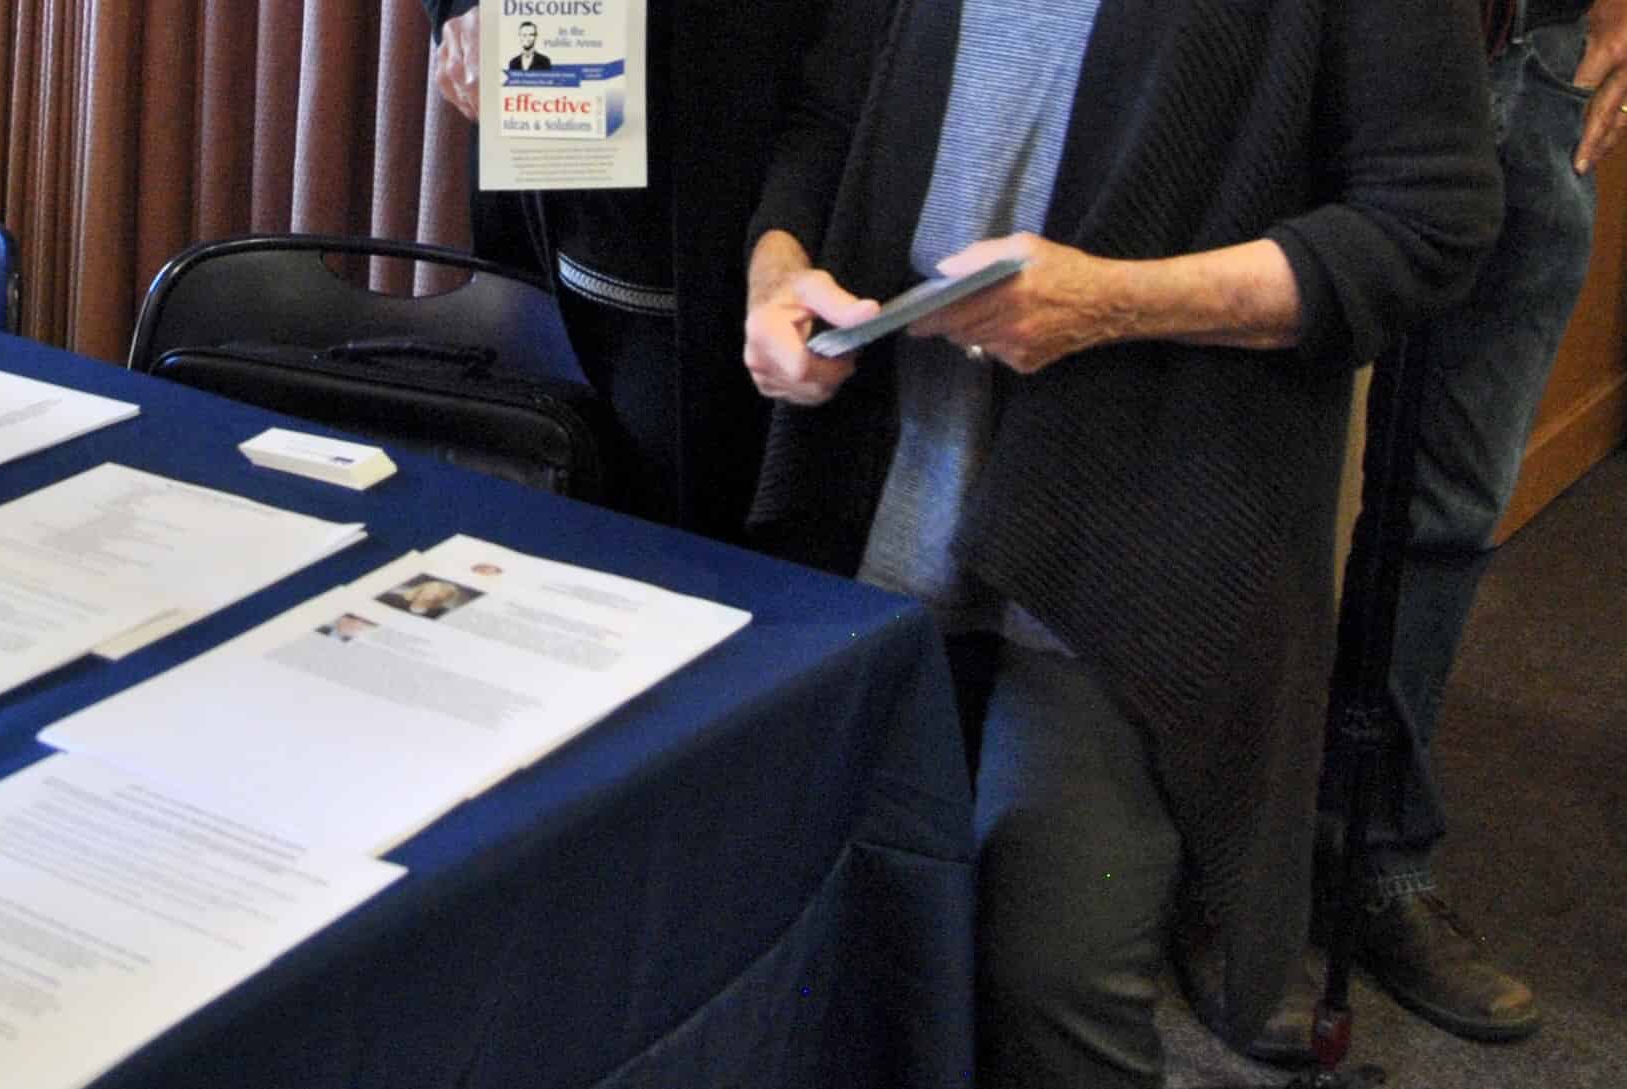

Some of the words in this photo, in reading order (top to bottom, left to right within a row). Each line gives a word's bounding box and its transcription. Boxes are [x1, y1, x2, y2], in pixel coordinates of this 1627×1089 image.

[570, 26, 585, 37] the
[503, 93, 591, 114] Effective
[503, 117, 530, 130] Ideas
[544, 118, 592, 131] Solutions
